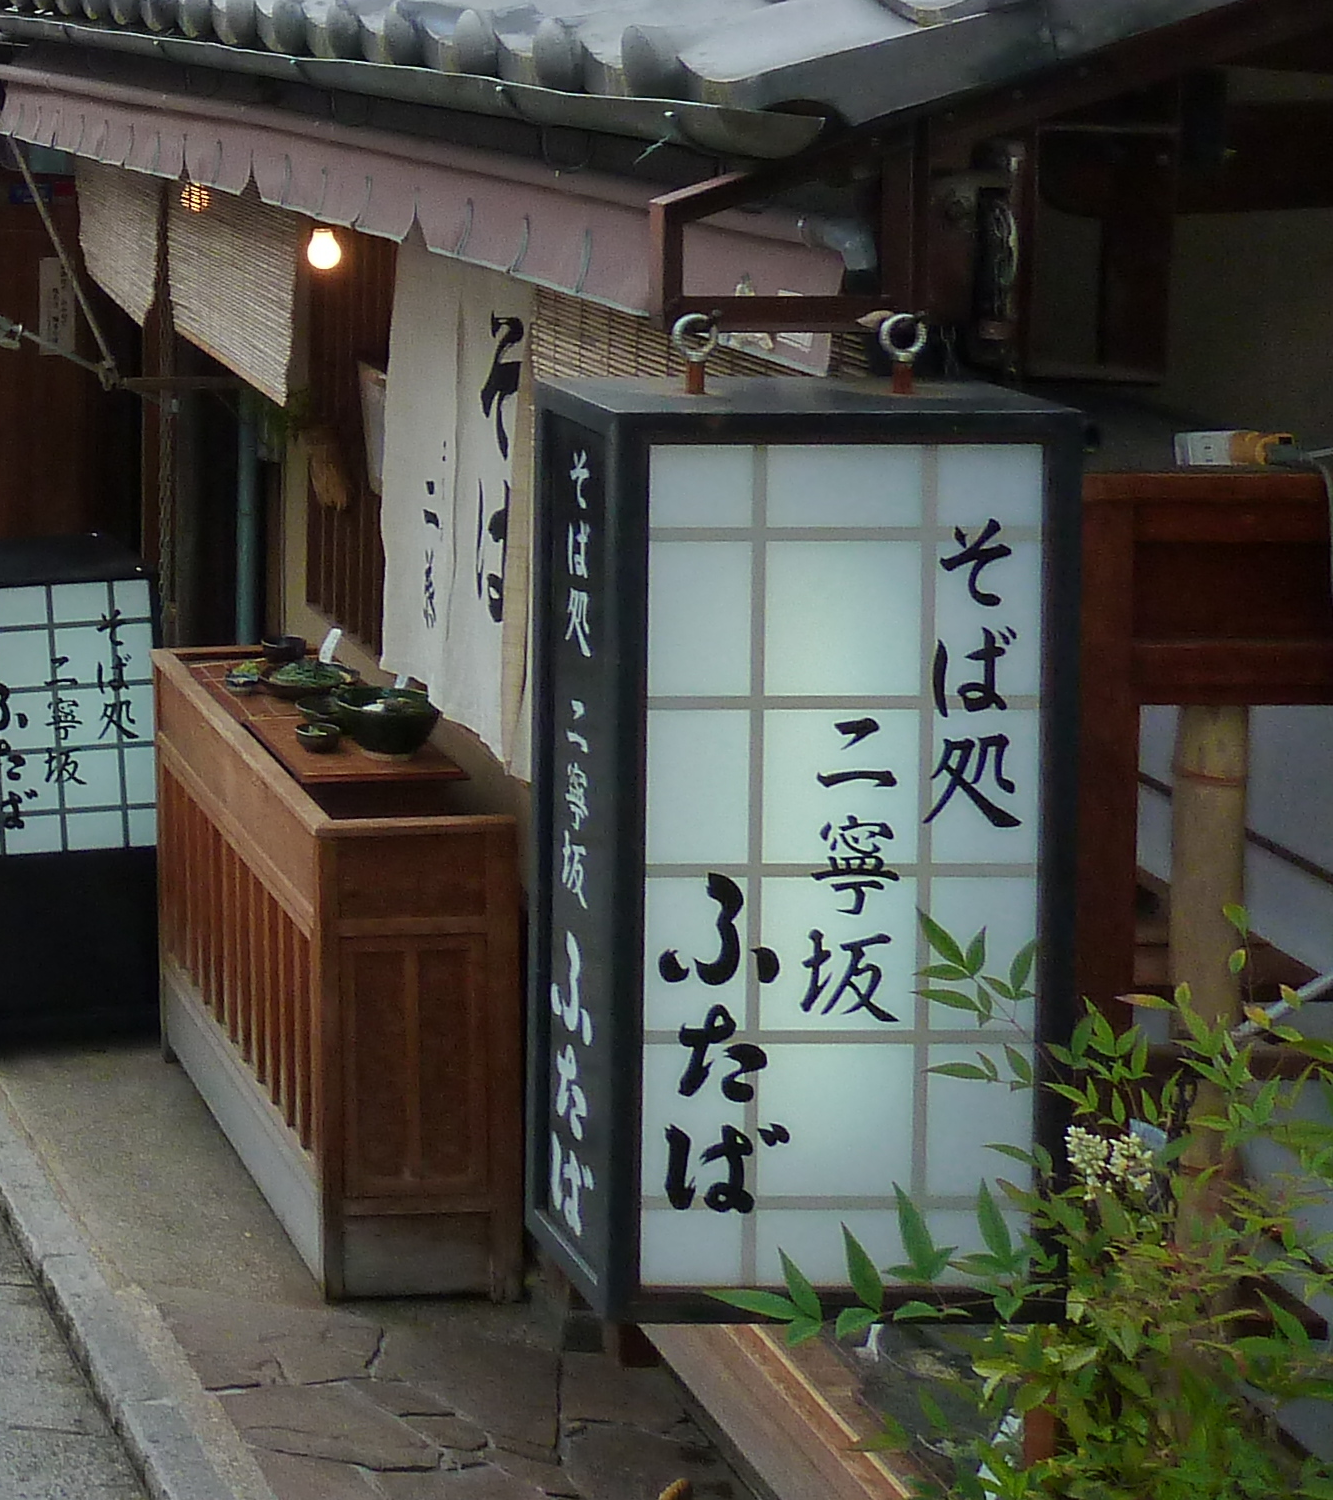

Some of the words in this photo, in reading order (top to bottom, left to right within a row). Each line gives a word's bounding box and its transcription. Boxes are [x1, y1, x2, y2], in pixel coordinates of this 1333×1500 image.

[95, 608, 140, 741] そば処
[564, 448, 593, 659] そば処
[922, 516, 1025, 829] そば処
[42, 655, 88, 787] 二寧坂
[561, 699, 590, 910] 二寧坂
[799, 716, 901, 1023] 二寧坂
[550, 929, 596, 1239] ふたば
[657, 871, 791, 1215] ふたば
